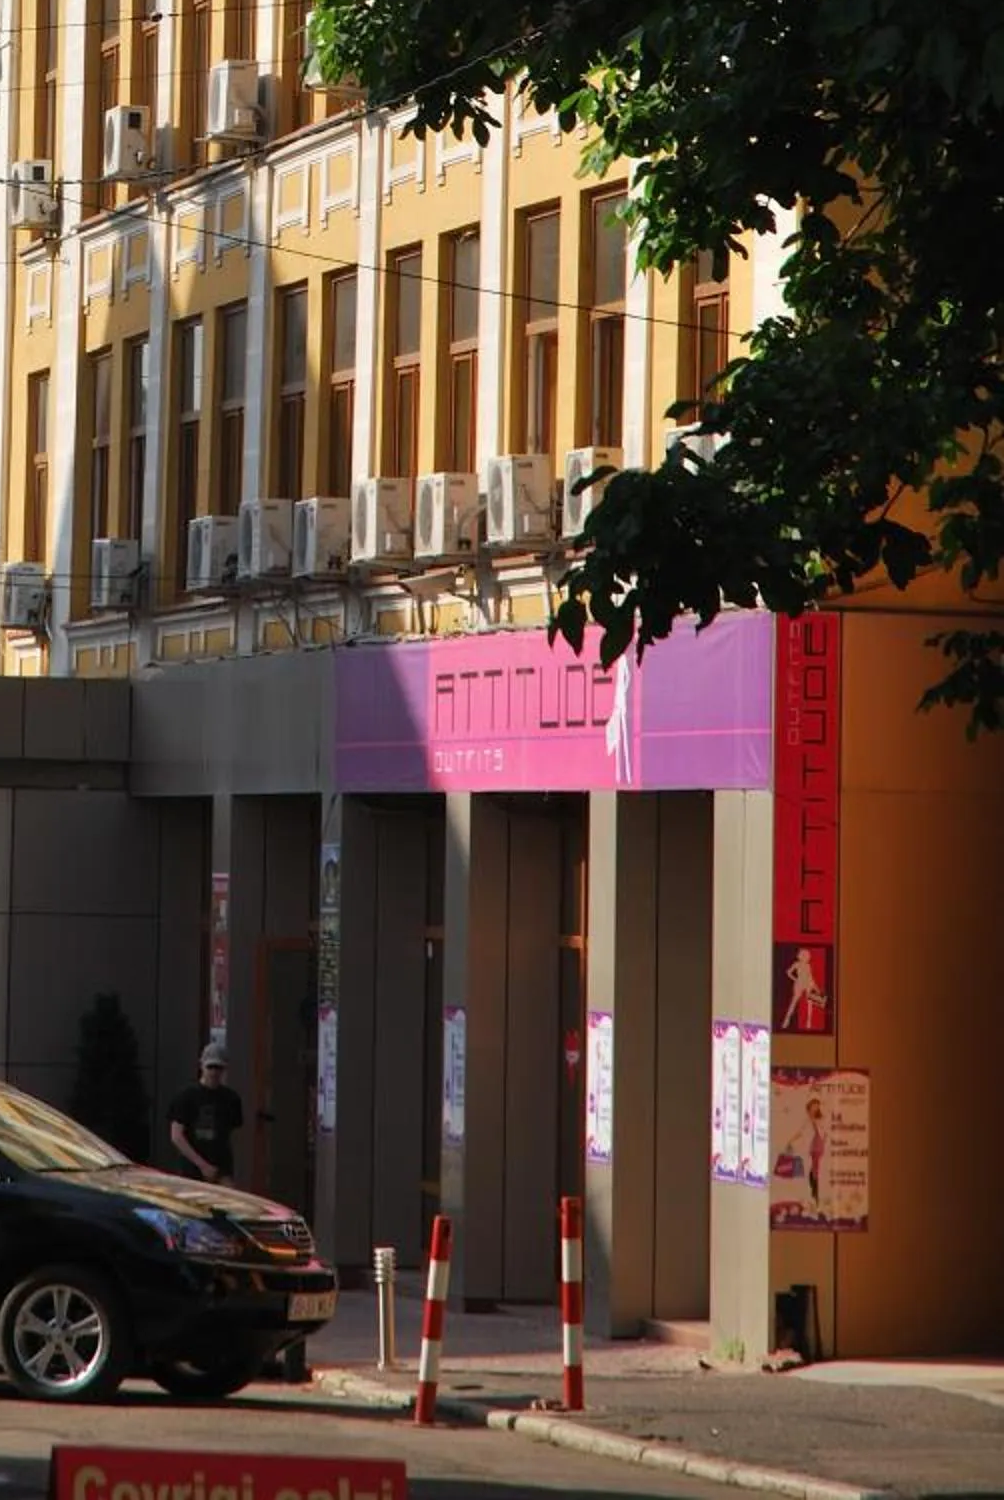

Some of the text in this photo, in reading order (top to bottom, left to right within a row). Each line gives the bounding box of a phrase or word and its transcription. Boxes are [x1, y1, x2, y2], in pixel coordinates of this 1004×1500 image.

[435, 663, 614, 734] ATTITUDE
[433, 748, 504, 774] OUTFITS
[800, 620, 828, 937] ATTITUDE
